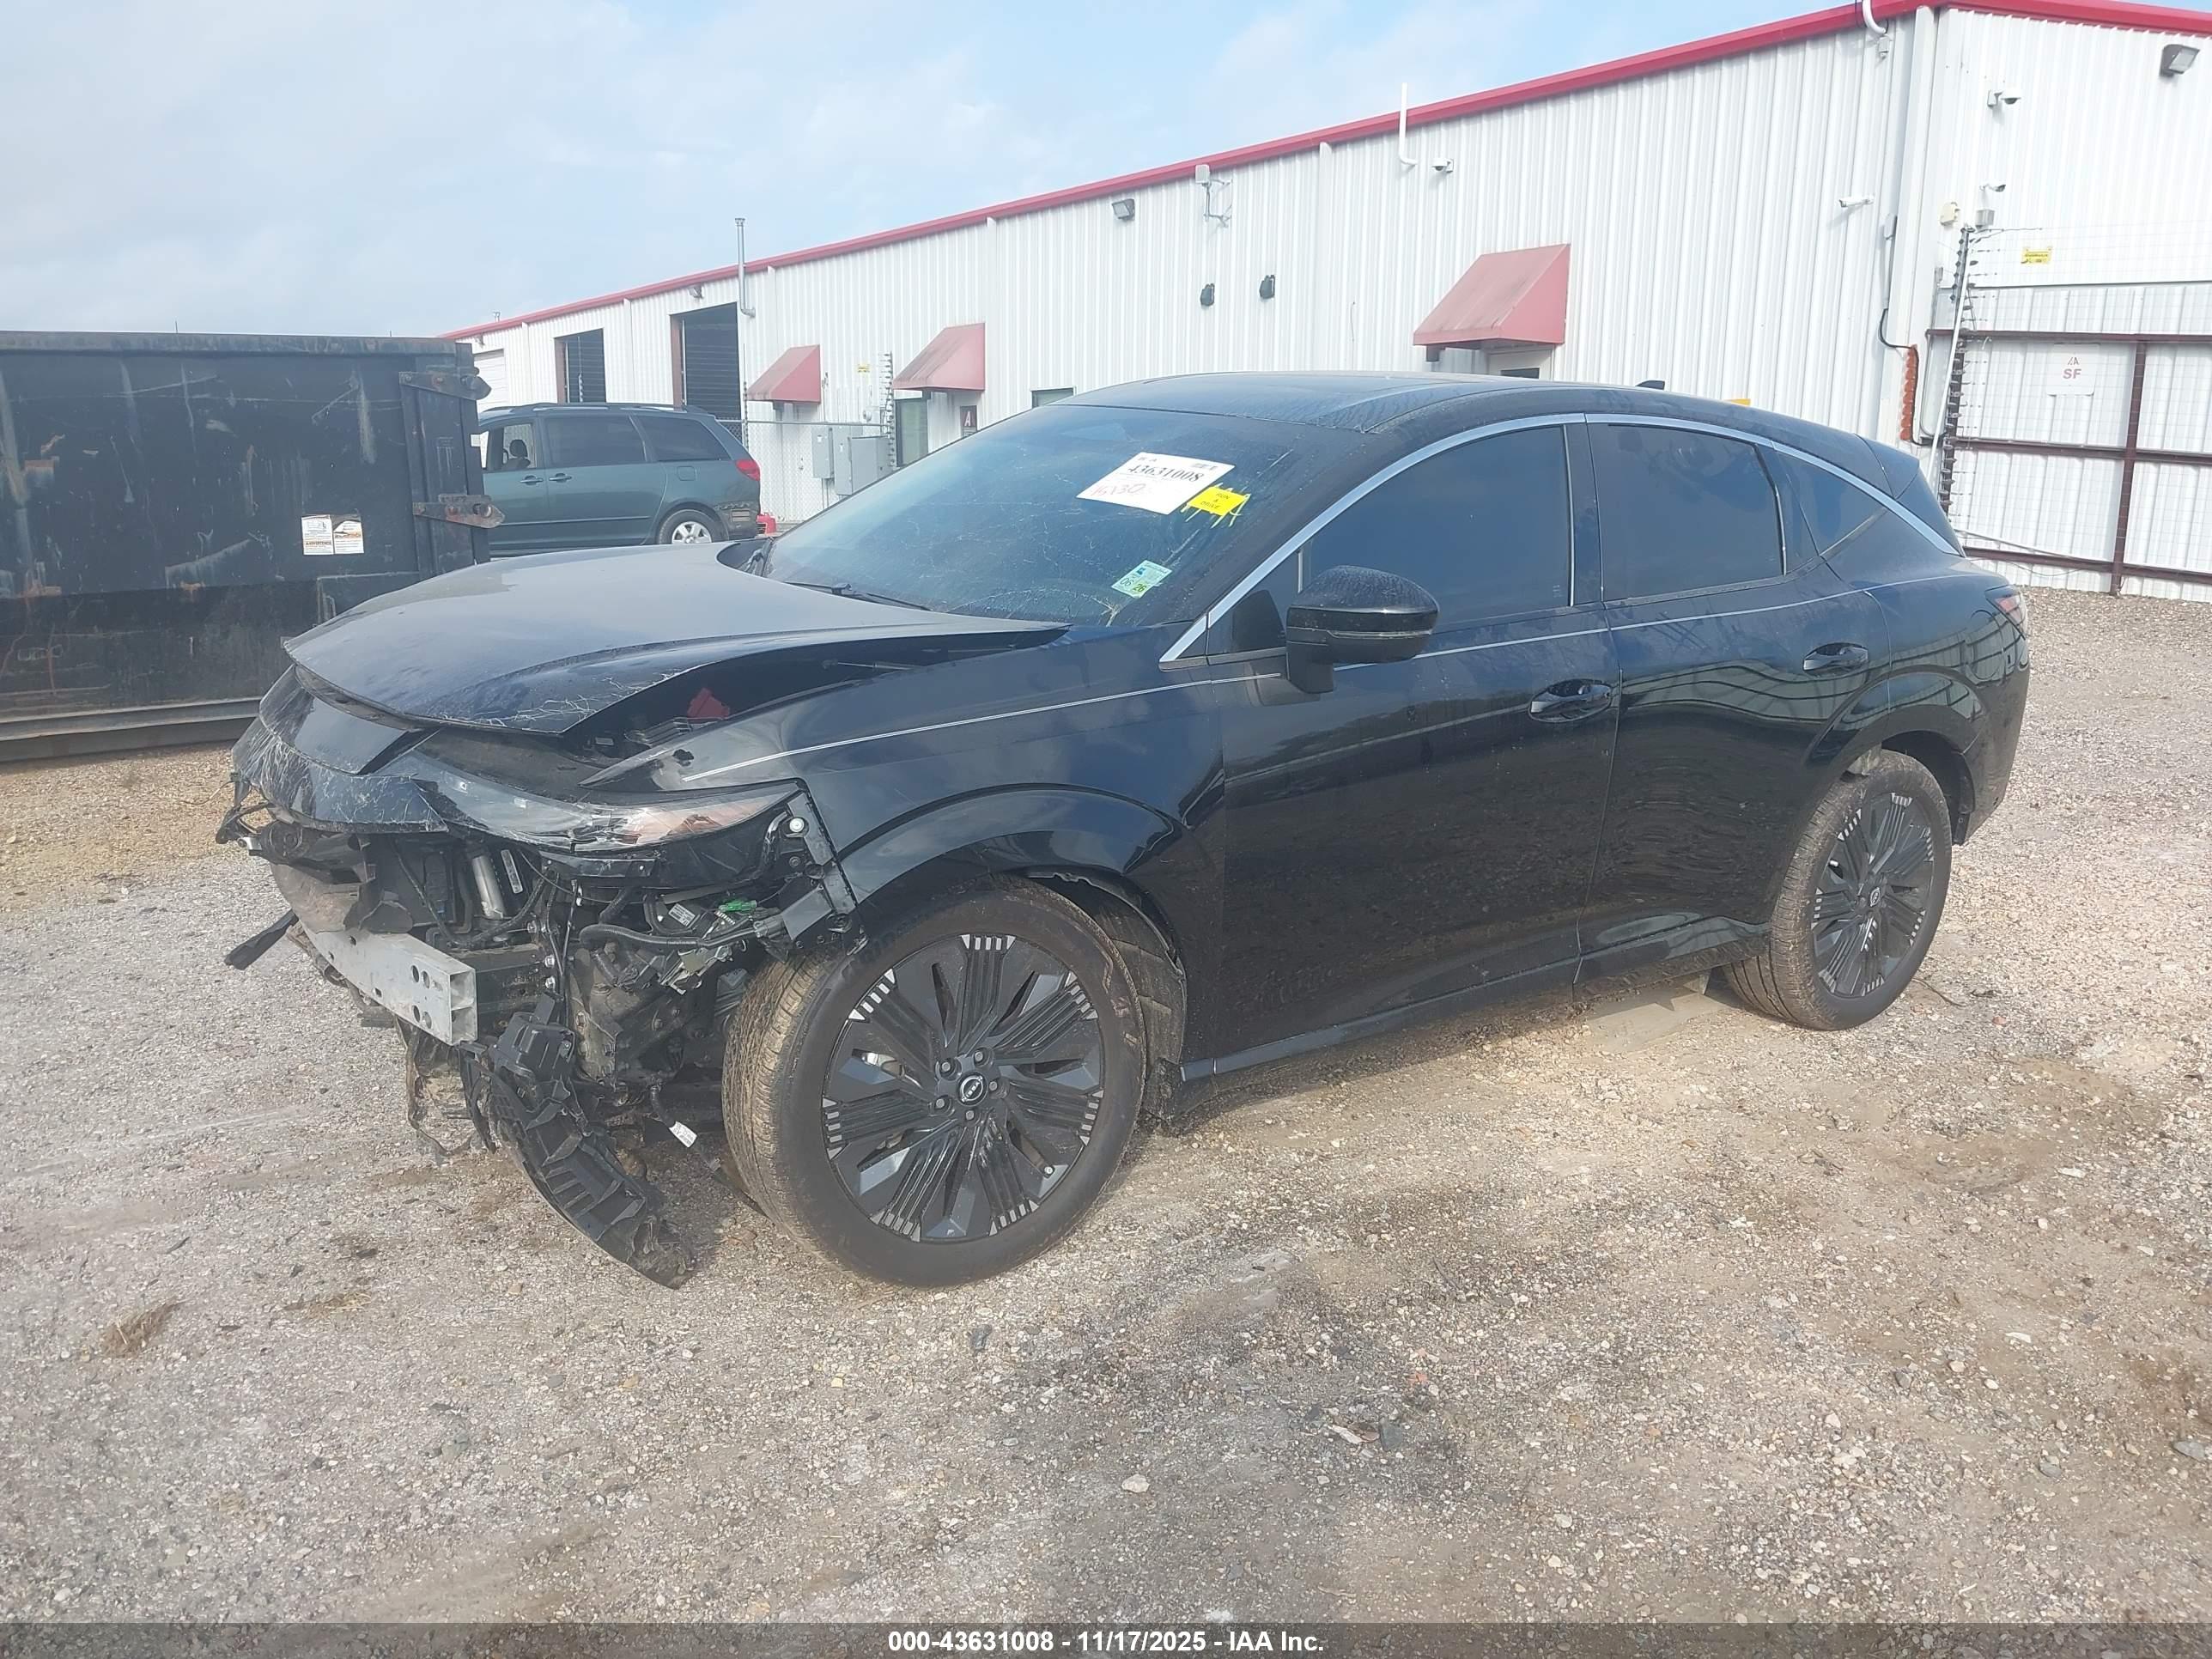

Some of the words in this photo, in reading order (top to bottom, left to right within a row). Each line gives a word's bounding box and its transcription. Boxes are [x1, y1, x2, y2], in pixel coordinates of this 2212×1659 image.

[2063, 368, 2081, 380] SF
[1128, 465, 1204, 482] 43631008
[1133, 583, 1147, 592] 26
